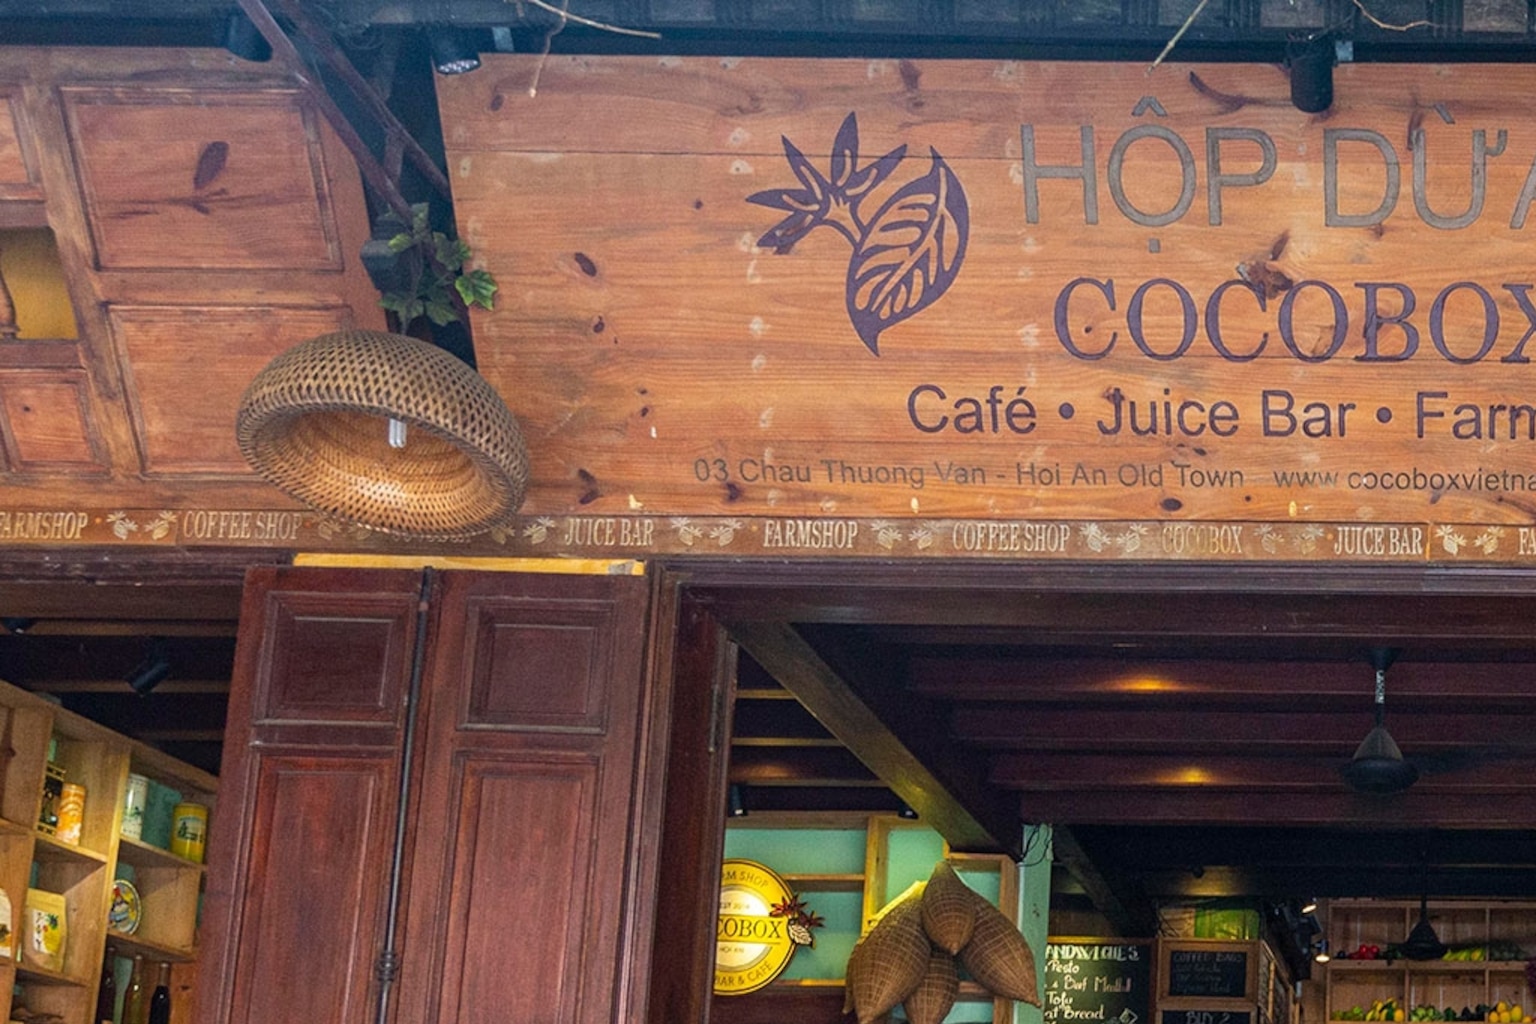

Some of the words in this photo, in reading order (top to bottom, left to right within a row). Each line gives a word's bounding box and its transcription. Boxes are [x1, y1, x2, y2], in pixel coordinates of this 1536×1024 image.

[1020, 96, 1277, 253] HỘP
[907, 383, 1037, 434] Café
[1096, 386, 1240, 437] Juice
[1261, 390, 1356, 438] Bar
[693, 458, 730, 482] 03
[739, 458, 811, 483] Chau
[820, 459, 924, 489] Thuong
[934, 461, 986, 485] Van
[1016, 462, 1061, 487] Hoi
[1071, 462, 1107, 487] An
[1117, 462, 1163, 488] Old
[1174, 463, 1244, 488] Town
[183, 510, 252, 540] COFFEE
[255, 511, 300, 541] SHOP
[563, 518, 616, 546] JUICE
[619, 519, 655, 547] BAR
[763, 519, 859, 549] FARMSHOP
[952, 522, 1021, 551] COFFEE
[1022, 523, 1071, 552] SHOP
[1161, 525, 1243, 554] COCOBOX
[1334, 527, 1388, 556] JUICE
[1389, 527, 1424, 556] BAR
[740, 870, 769, 888] SHOP
